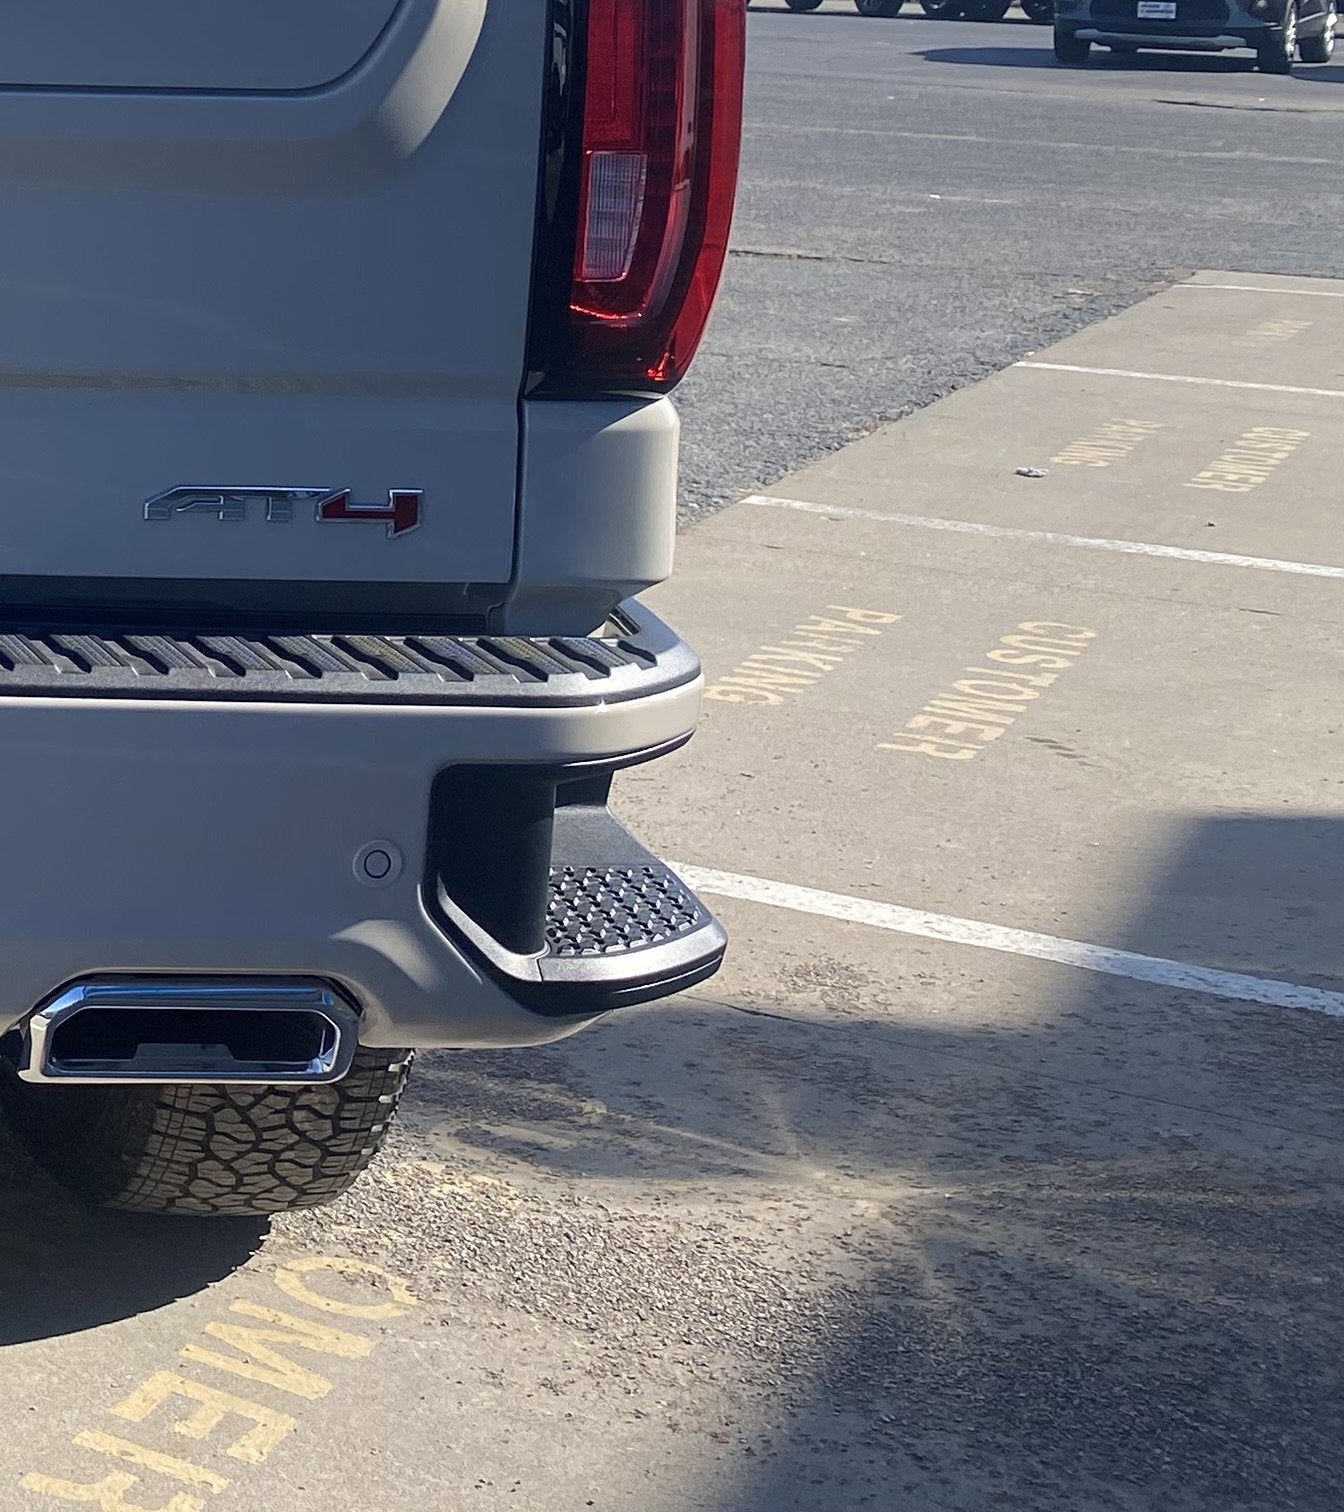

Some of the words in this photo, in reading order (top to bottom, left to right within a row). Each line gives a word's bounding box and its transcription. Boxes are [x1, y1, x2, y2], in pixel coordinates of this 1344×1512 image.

[1180, 425, 1312, 493] CUSTOMER
[143, 484, 425, 539] AT4
[703, 604, 904, 706] PARKING
[875, 620, 1100, 761] CUSTOMER
